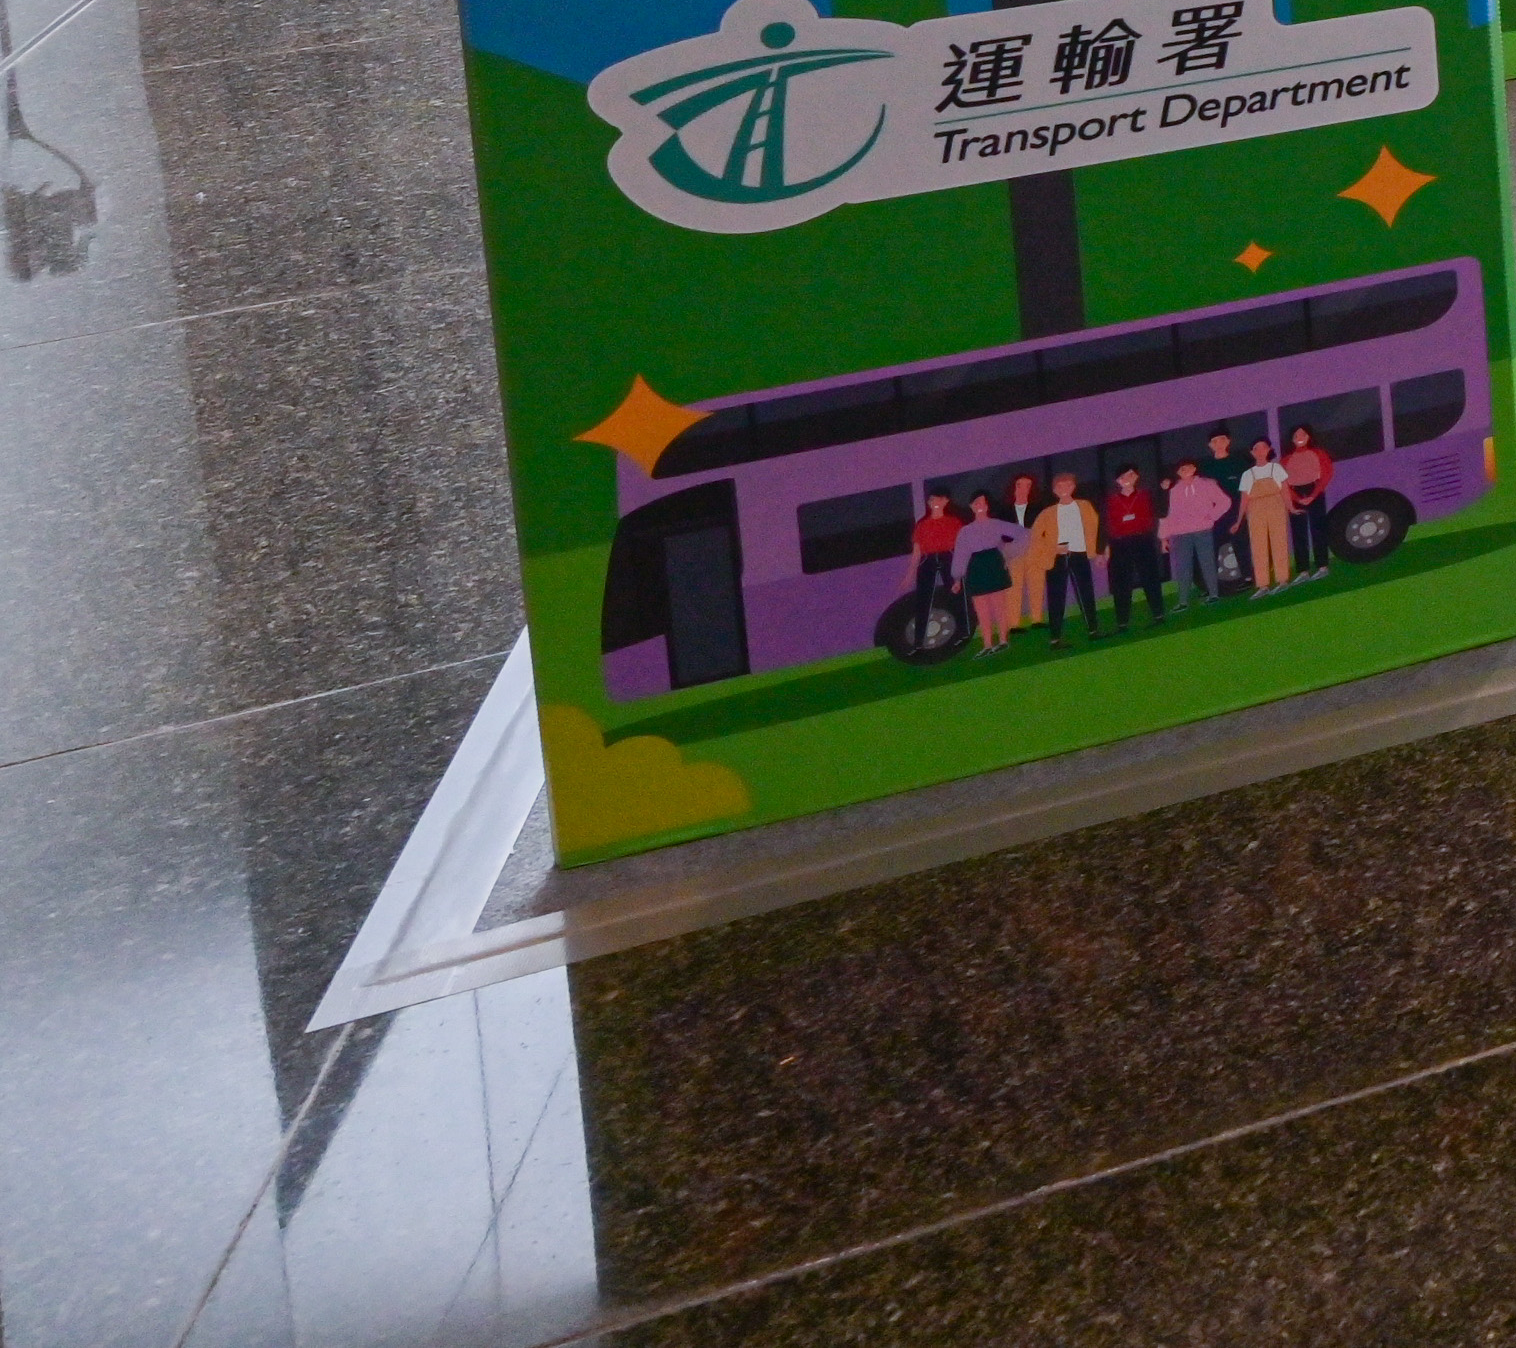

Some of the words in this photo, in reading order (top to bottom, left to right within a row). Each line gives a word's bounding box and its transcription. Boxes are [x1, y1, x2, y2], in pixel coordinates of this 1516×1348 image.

[935, 0, 1245, 115] 運輸署
[935, 107, 1147, 166] Transport
[1158, 61, 1410, 131] Department
